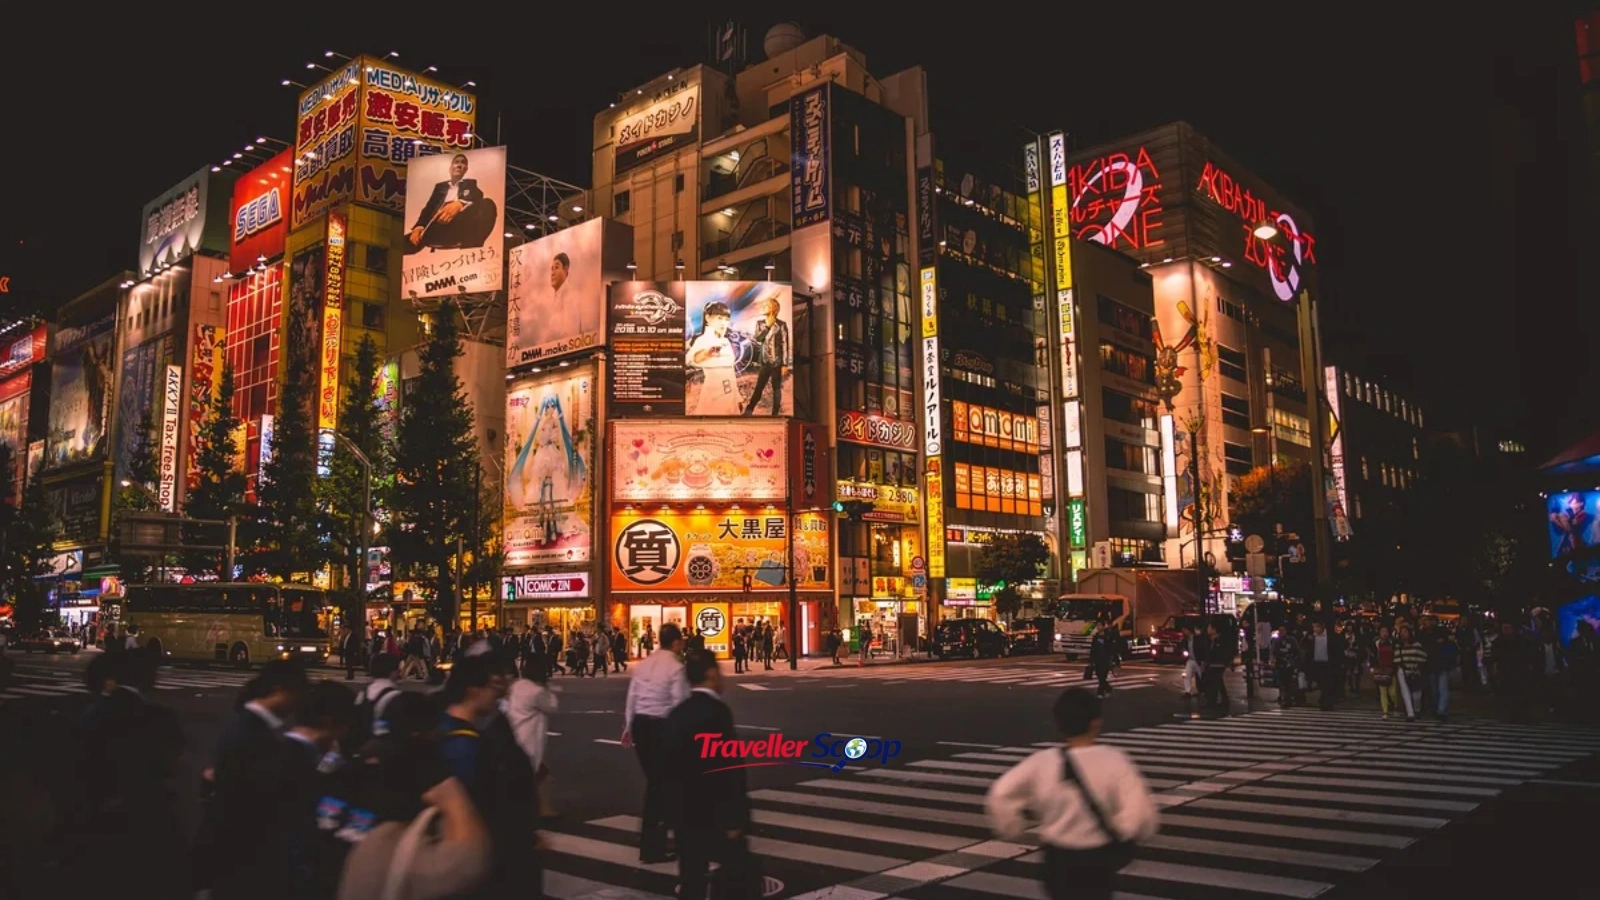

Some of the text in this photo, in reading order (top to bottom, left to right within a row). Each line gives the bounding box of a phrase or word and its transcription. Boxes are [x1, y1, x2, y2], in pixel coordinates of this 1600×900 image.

[365, 90, 472, 147] 激安販売
[235, 187, 283, 242] SEGA
[425, 274, 478, 293] DMM.com
[163, 417, 178, 472] Tax-free
[839, 413, 916, 447] メイドカジノ
[159, 472, 174, 507] Shop
[718, 518, 786, 541] 大黒屋
[623, 529, 672, 576] 質
[527, 581, 557, 592] COMIC
[700, 612, 721, 632] 質
